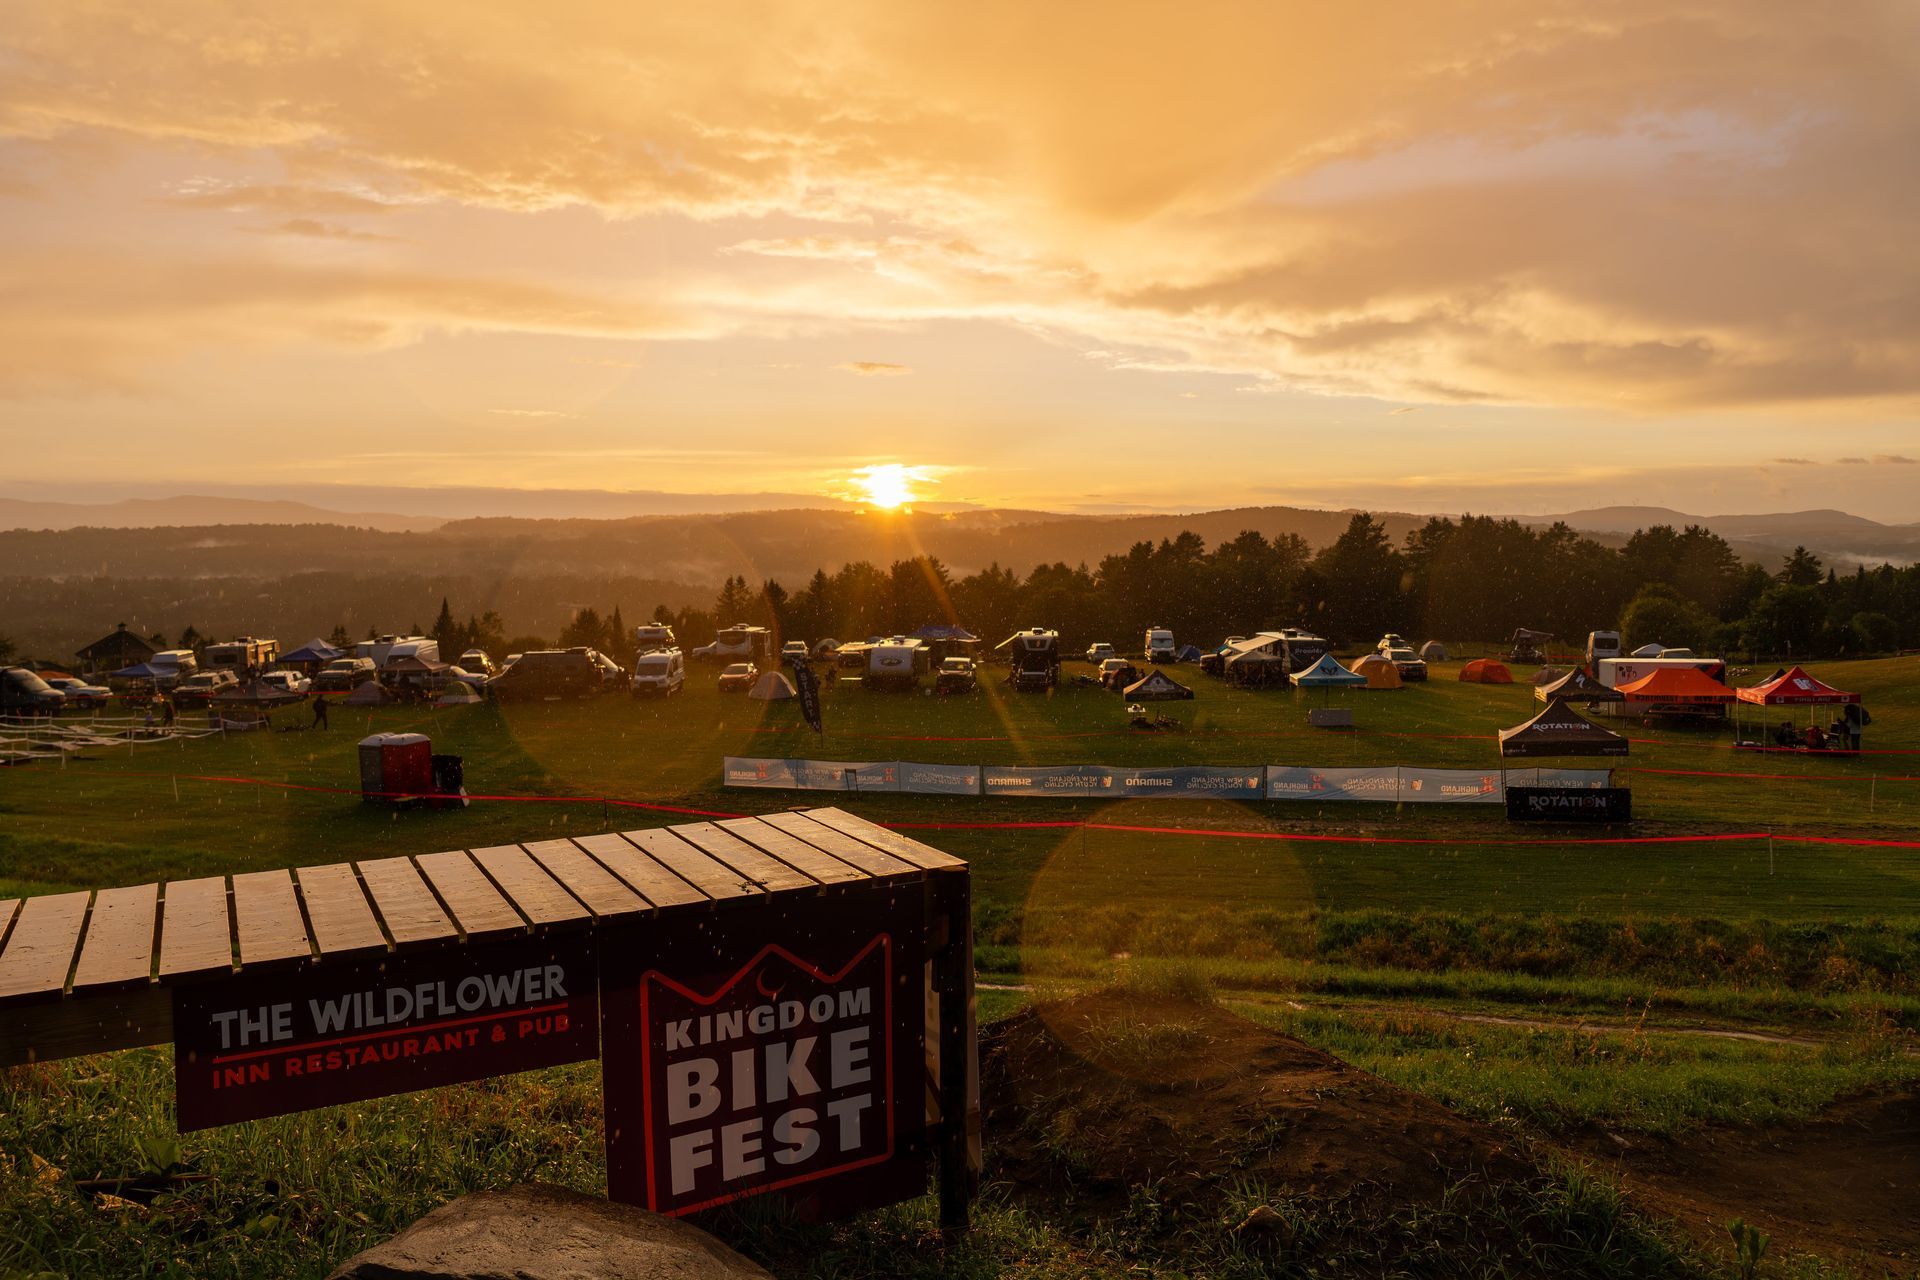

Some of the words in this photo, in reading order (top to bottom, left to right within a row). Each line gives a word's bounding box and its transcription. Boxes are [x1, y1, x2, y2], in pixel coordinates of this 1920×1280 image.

[1532, 723, 1590, 732] ROTATION
[1529, 795, 1606, 810] ROTATION
[212, 1003, 294, 1048] THE
[311, 965, 568, 1034] WILDFLOWER
[665, 987, 872, 1052] KINGDOM
[213, 1063, 271, 1089] INN
[286, 1028, 479, 1076] RESTAURANT
[491, 1025, 506, 1043] &
[518, 1014, 570, 1036] PUB
[666, 1025, 872, 1126] BIKE
[670, 1095, 873, 1196] FEST
